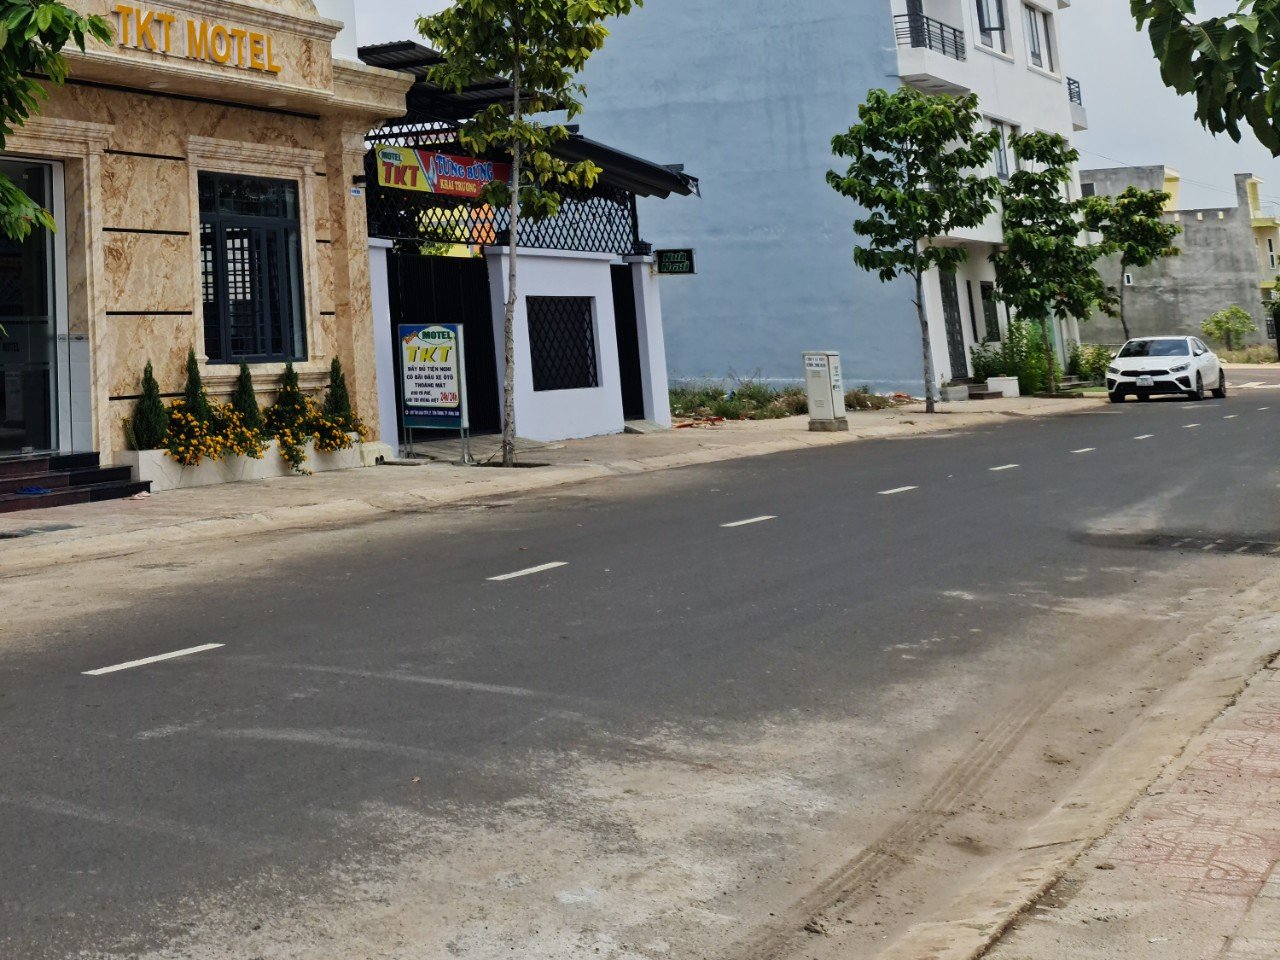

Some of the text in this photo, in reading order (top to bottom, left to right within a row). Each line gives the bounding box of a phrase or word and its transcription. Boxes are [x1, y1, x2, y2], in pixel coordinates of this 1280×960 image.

[114, 4, 282, 74] TKT MOTEL
[382, 161, 419, 187] TKT
[440, 179, 455, 191] KHAI
[422, 331, 453, 340] MOTEL
[406, 346, 452, 362] TKT
